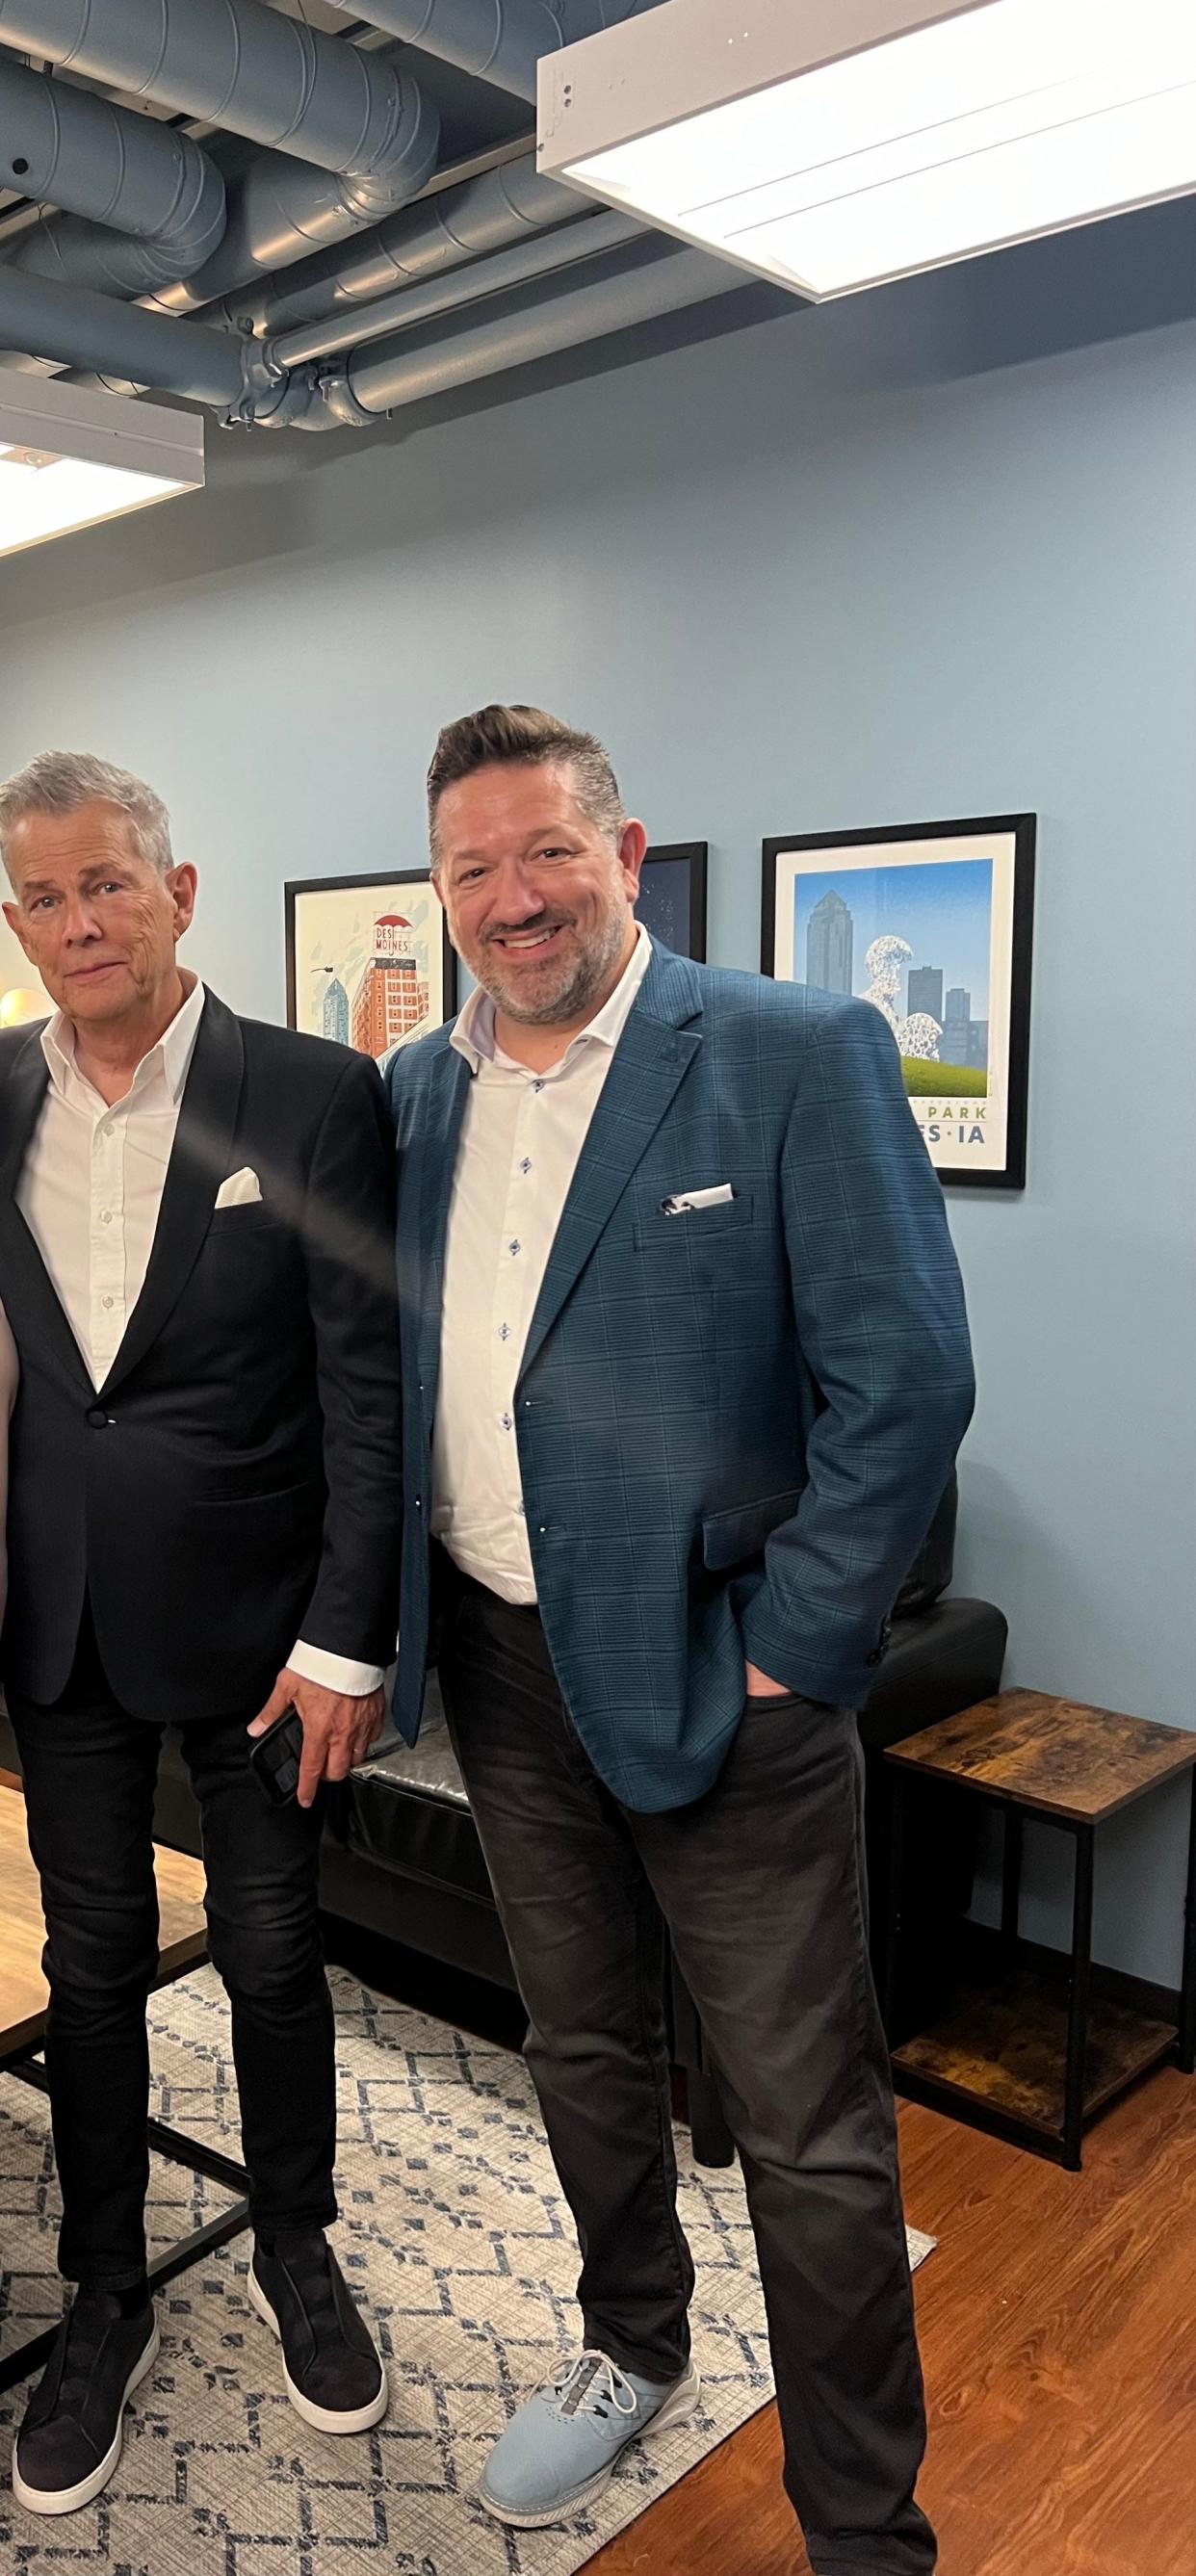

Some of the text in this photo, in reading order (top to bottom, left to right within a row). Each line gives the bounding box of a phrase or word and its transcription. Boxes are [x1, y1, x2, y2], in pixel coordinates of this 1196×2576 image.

[377, 927, 392, 939] DES
[377, 939, 408, 951] MOINES
[928, 1106, 986, 1119] PARK
